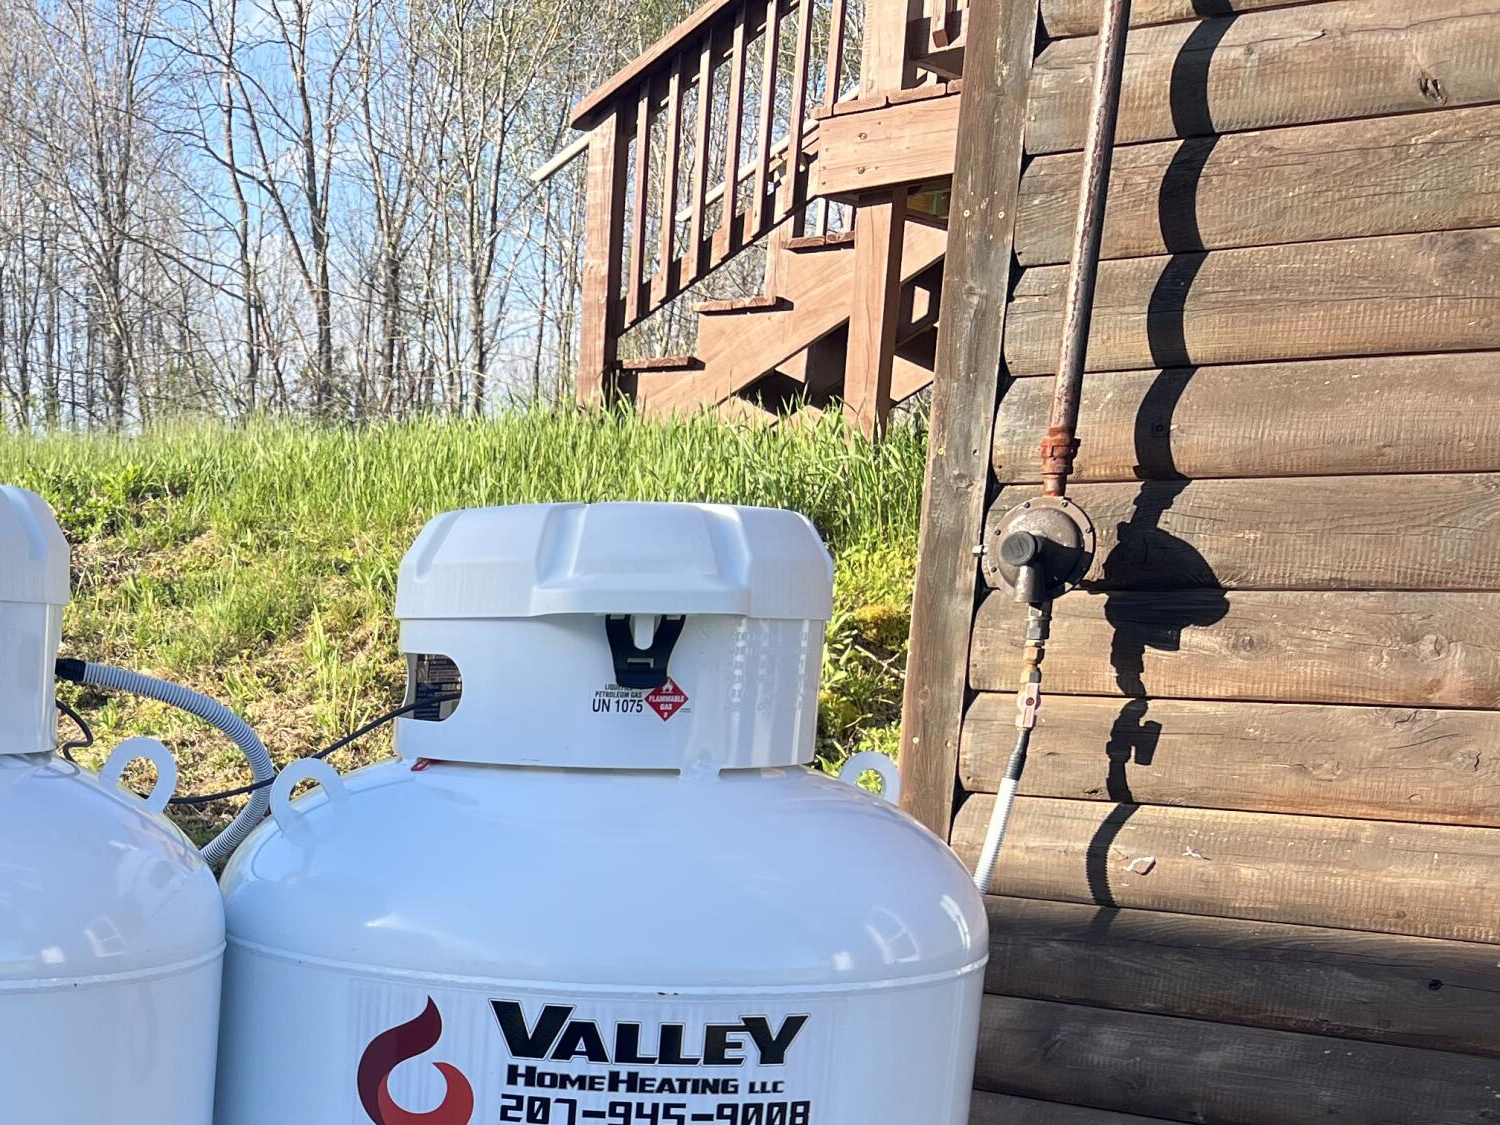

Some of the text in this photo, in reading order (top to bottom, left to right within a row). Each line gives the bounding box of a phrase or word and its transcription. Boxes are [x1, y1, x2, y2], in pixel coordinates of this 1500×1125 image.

[595, 690, 629, 698] PETROLEUM
[592, 698, 643, 714] UN 1075
[489, 998, 810, 1066] VALLEY
[748, 1081, 785, 1094] LLC
